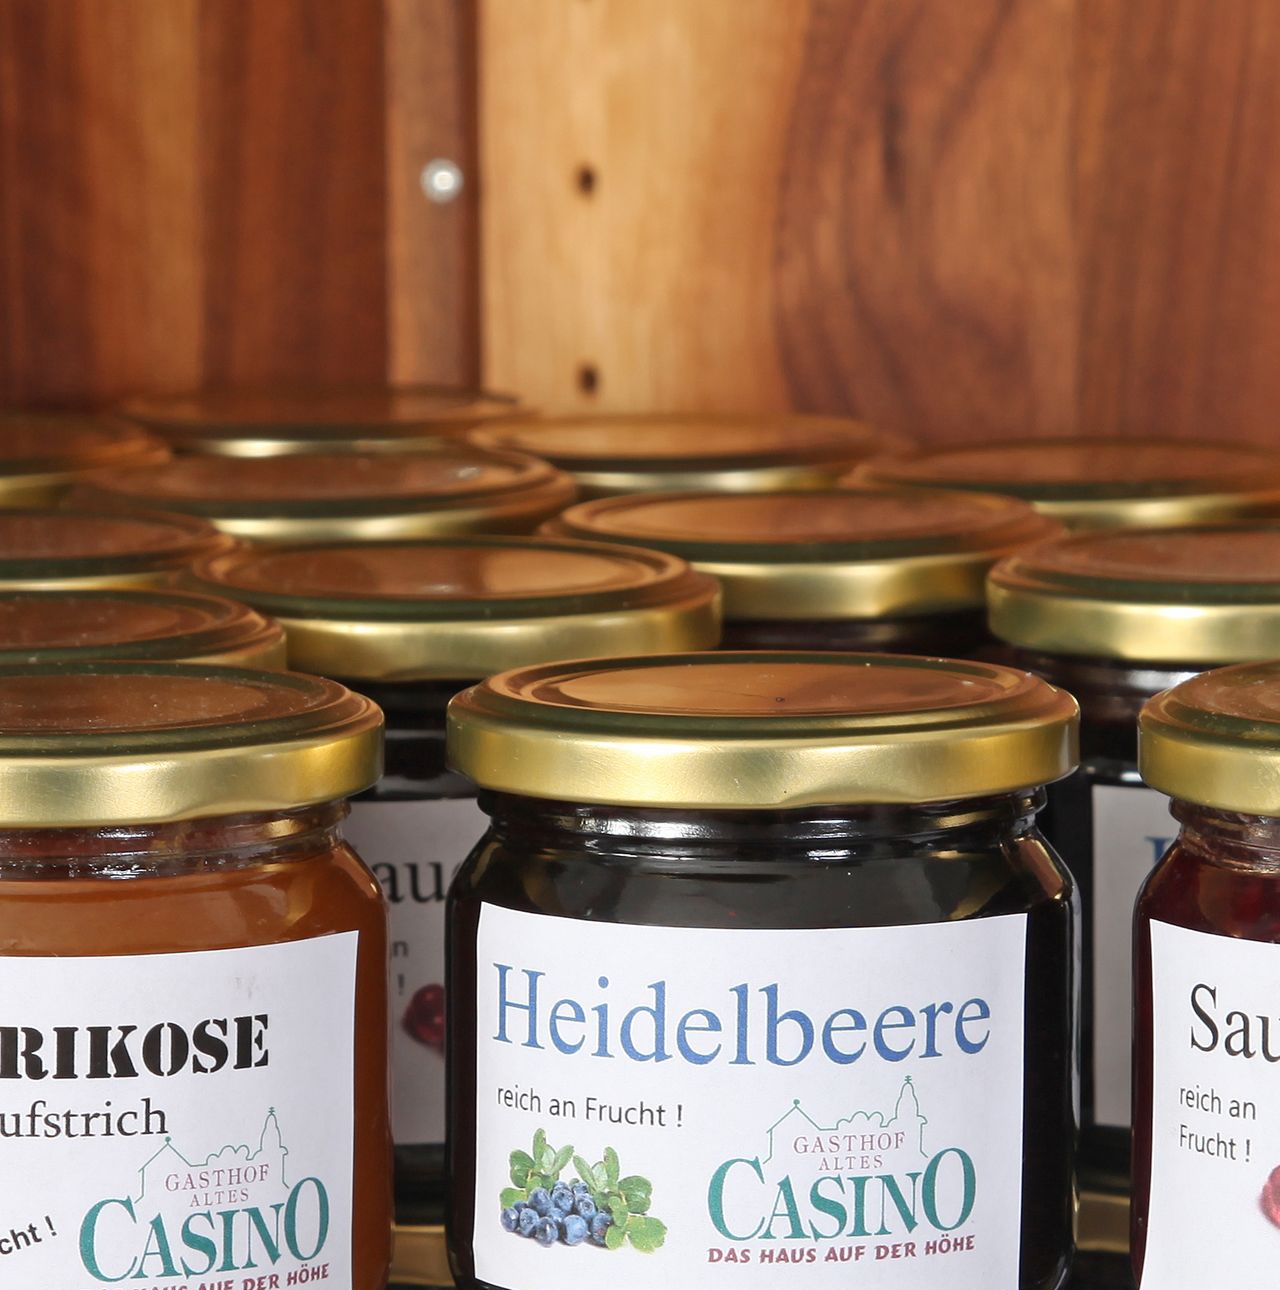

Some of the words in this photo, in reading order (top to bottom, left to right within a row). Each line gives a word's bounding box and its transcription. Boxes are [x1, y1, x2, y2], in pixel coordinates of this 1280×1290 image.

[492, 961, 991, 1067] Heidelbeere
[497, 1084, 542, 1115] reich
[548, 1097, 576, 1119] an
[586, 1097, 666, 1128] Frucht
[1179, 1084, 1222, 1116] reich
[1228, 1097, 1257, 1121] an
[793, 1131, 906, 1156] GASTHOF
[1179, 1124, 1237, 1162] Frucht
[165, 1163, 270, 1193] GASTHOF
[819, 1154, 884, 1171] ALTES
[189, 1188, 249, 1208] ALTES
[707, 1147, 977, 1243] CASINO
[79, 1177, 330, 1283] CASINO
[707, 1247, 751, 1264] DAS
[758, 1246, 817, 1264] HAUS
[824, 1244, 866, 1263] AUF
[874, 1241, 917, 1261] DER
[924, 1233, 976, 1256] HÖHE
[286, 1261, 330, 1287] HÖHE
